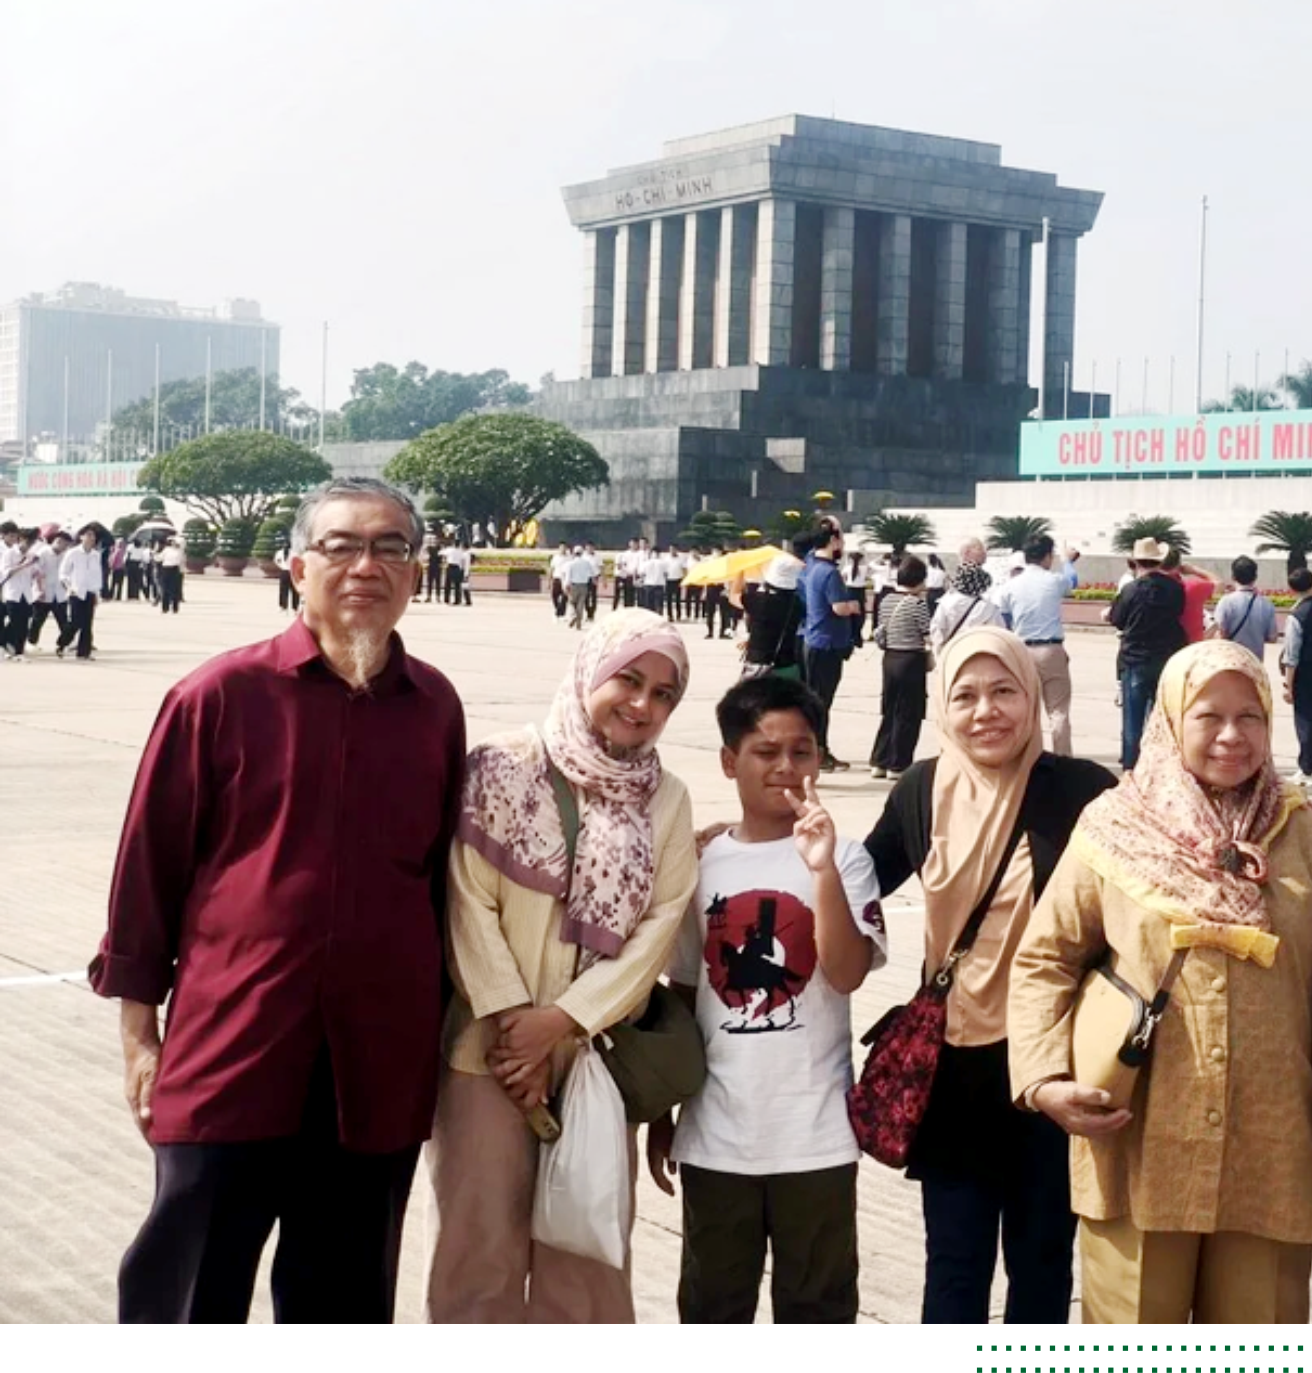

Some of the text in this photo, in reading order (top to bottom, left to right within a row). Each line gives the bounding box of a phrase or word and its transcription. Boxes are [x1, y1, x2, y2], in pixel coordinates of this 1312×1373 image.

[1059, 421, 1102, 465] CHỦ
[1113, 428, 1165, 469] TỊCH
[1218, 416, 1261, 461] CHÍ
